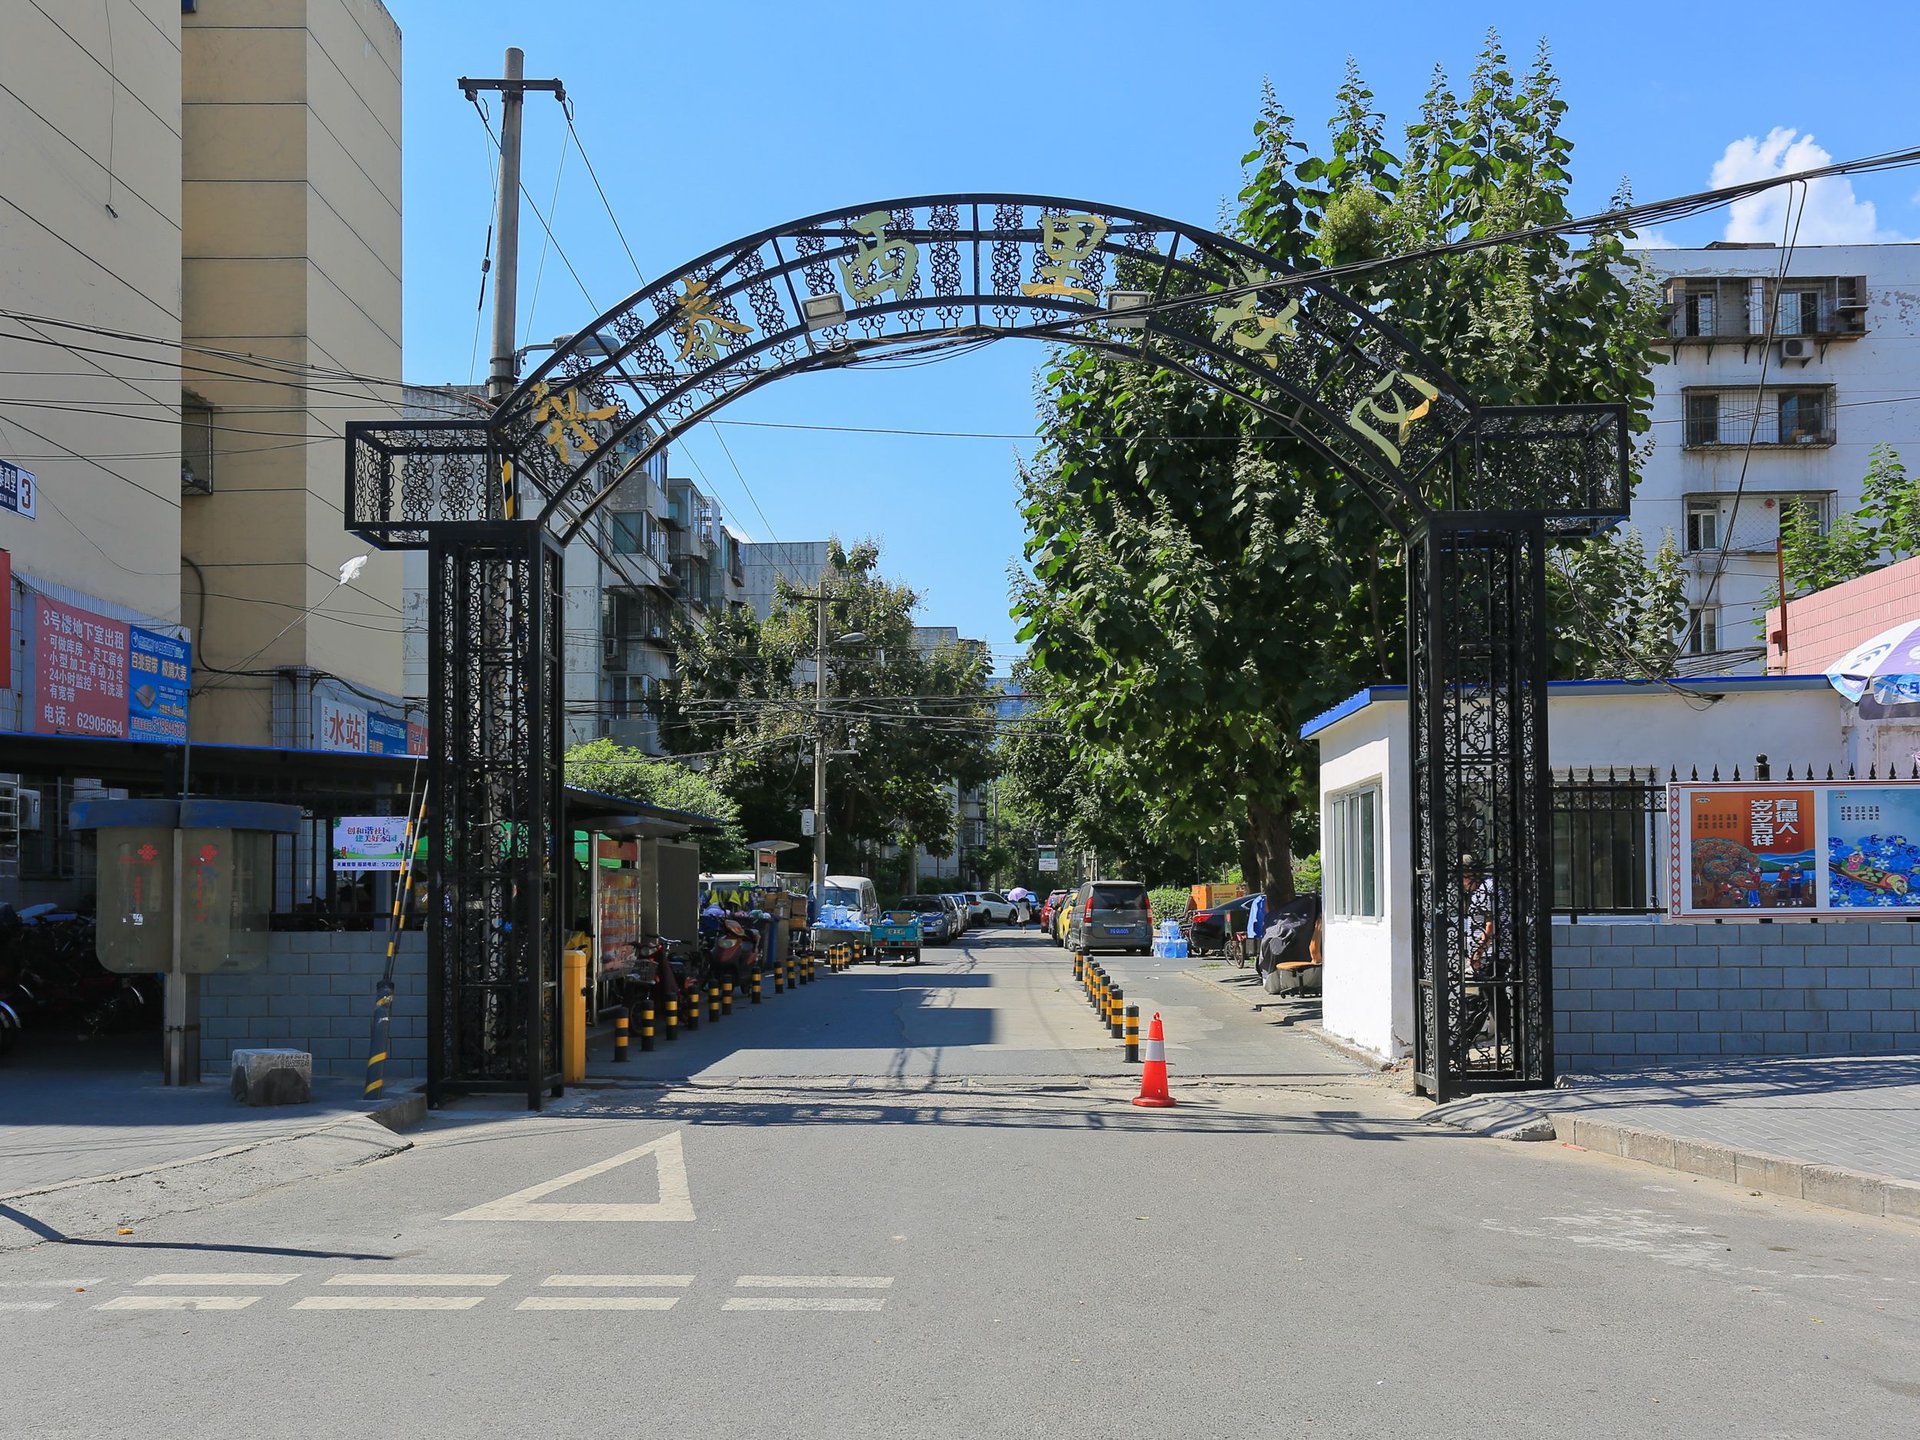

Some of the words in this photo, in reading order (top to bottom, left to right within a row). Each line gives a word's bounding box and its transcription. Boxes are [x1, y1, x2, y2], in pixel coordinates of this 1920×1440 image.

[21, 478, 31, 509] 3
[43, 609, 124, 650] 3号楼地下室出租
[49, 633, 84, 657] 可做库房
[92, 646, 124, 668] 员工宿舍
[49, 650, 124, 684] 小型加工有动力电
[49, 667, 92, 691] 24小时监控
[99, 679, 124, 699] 可洗澡
[49, 683, 76, 703] 有宽带
[76, 711, 123, 737] 62905654
[329, 709, 362, 751] 水站
[1751, 799, 1774, 847] 岁岁吉祥
[1775, 798, 1799, 835] 有德人
